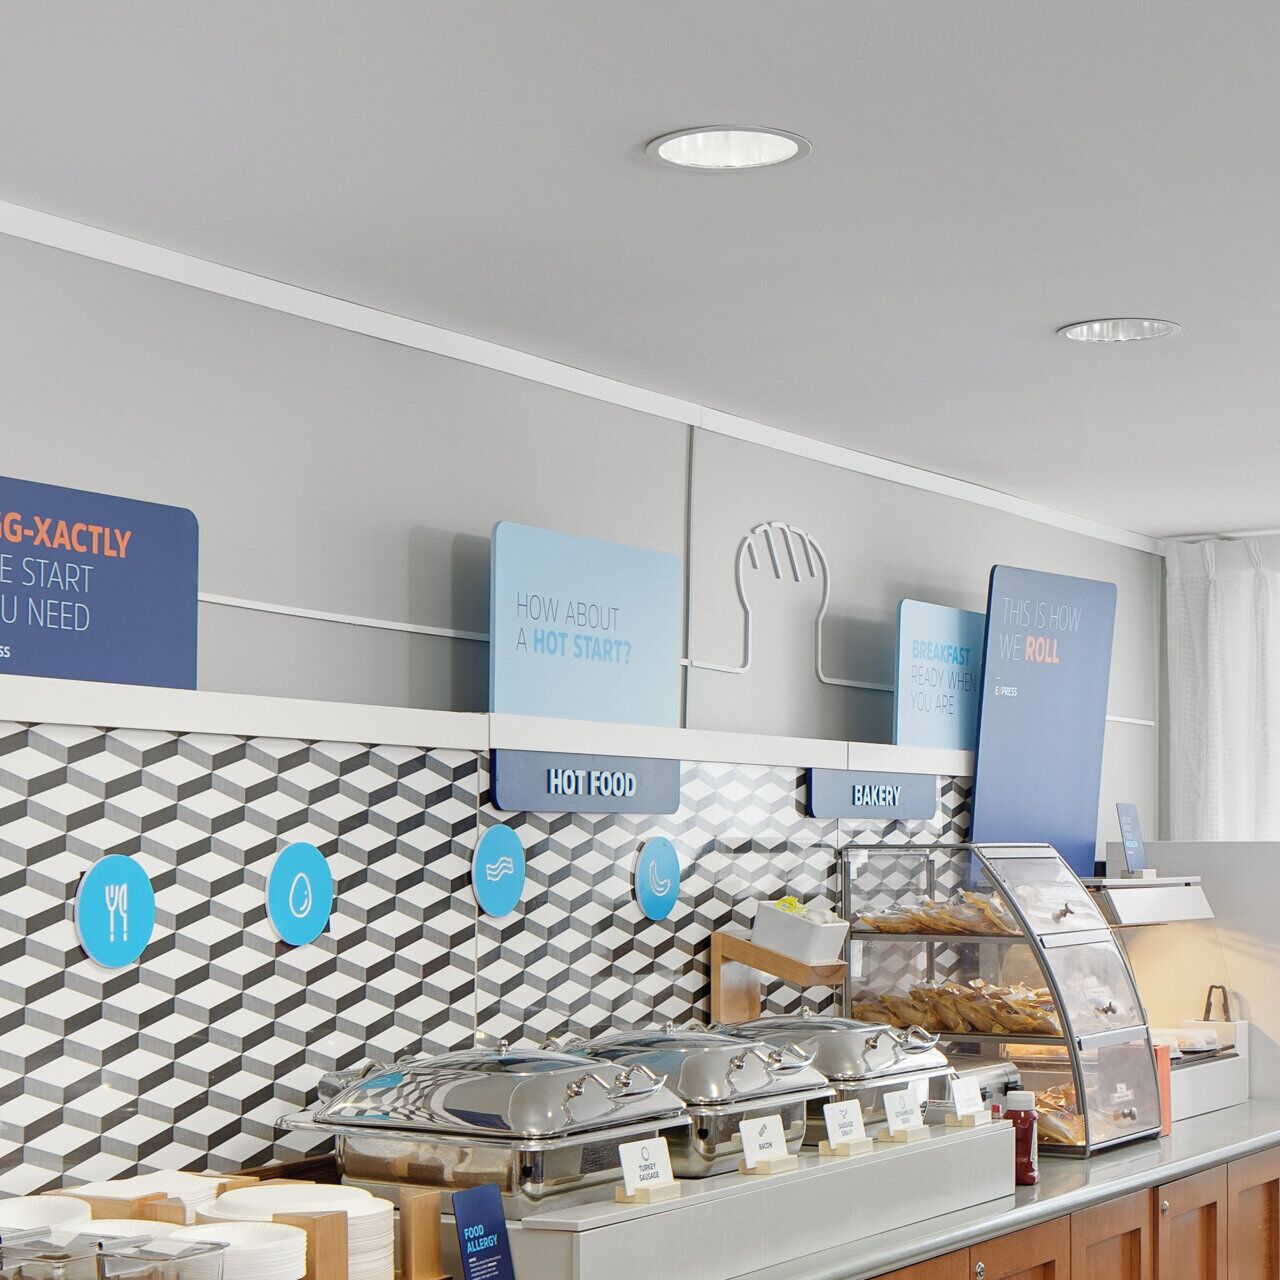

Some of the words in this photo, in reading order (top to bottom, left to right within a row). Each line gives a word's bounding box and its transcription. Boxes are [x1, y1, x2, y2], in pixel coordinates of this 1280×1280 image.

[22, 557, 94, 593] START
[28, 597, 90, 632] NEED
[516, 592, 560, 623] HOW
[565, 601, 620, 631] ABOUT
[1003, 597, 1031, 627] THIS
[1035, 601, 1046, 629] IS
[1049, 604, 1082, 632] HOW
[516, 627, 528, 652] A
[533, 628, 569, 657] HOT
[573, 634, 632, 664] START?
[911, 639, 971, 666] BREAKFAST
[1000, 633, 1021, 661] WE
[1025, 635, 1060, 664] ROLL
[911, 665, 945, 688] READY
[948, 669, 977, 692] WHEN
[995, 686, 1018, 697] EPRESS
[911, 690, 932, 713] YOU
[935, 693, 955, 715] ARE
[548, 768, 586, 795] HOT
[589, 770, 637, 797] FOOD
[852, 784, 901, 806] BAKERY
[758, 1142, 773, 1151] BACON
[638, 1162, 657, 1173] TURKEY
[638, 1171, 660, 1182] SAUSAGE
[464, 1224, 484, 1239] FOOD
[467, 1234, 498, 1253] ALLERGY
